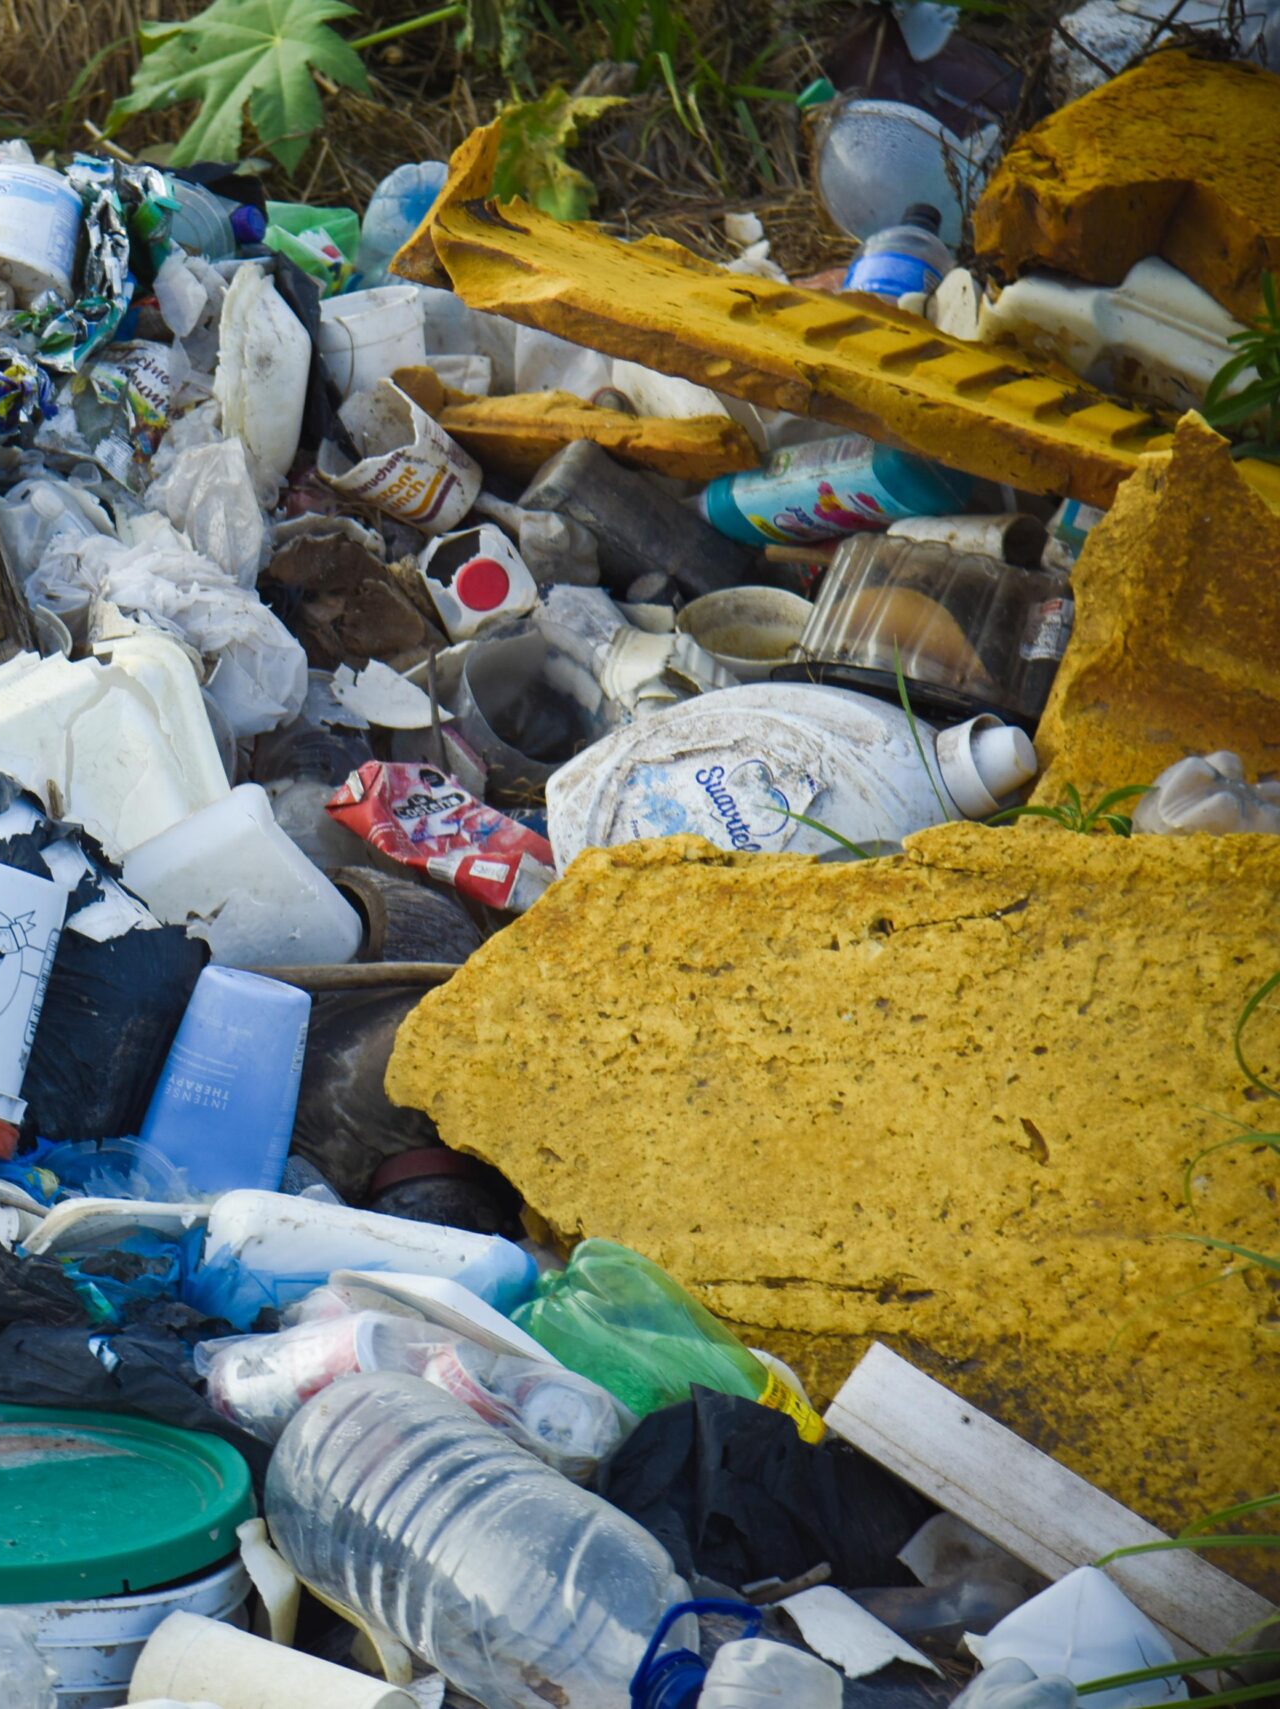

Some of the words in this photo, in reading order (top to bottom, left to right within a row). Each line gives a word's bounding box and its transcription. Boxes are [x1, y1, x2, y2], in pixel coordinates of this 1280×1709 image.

[386, 478, 428, 510] unch
[164, 1083, 227, 1111] INTENSE
[168, 1073, 231, 1100] THERAPY
